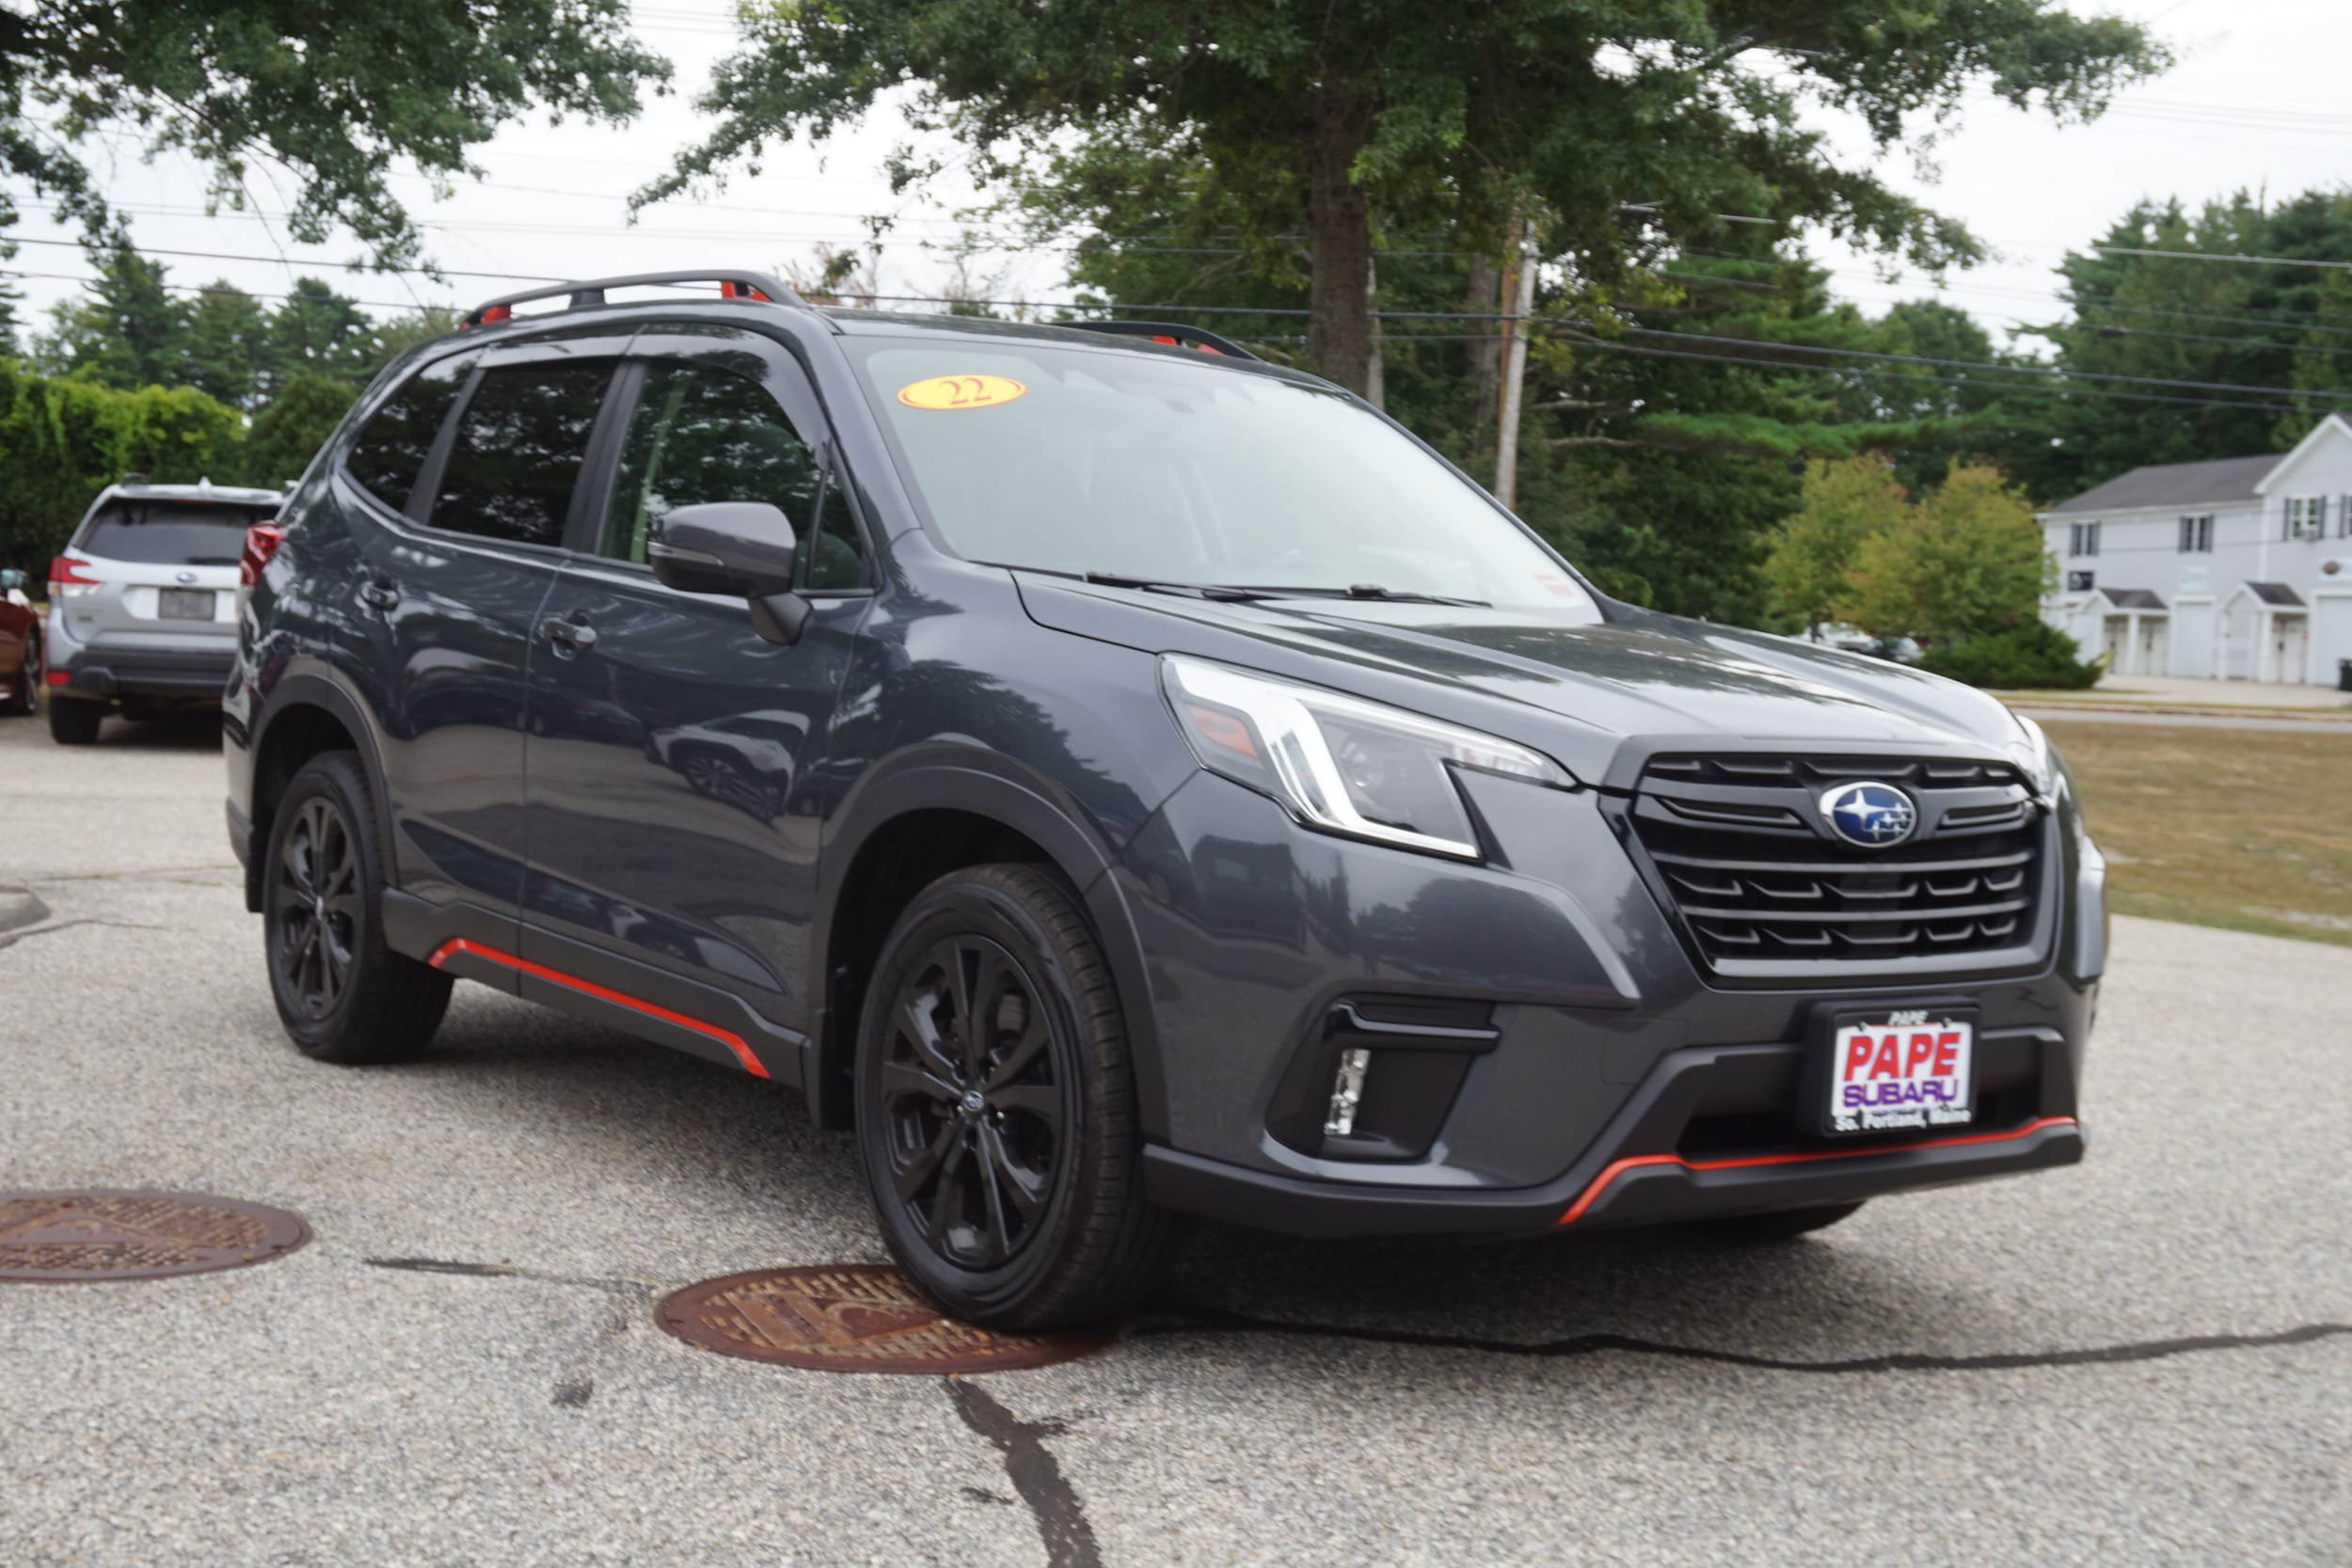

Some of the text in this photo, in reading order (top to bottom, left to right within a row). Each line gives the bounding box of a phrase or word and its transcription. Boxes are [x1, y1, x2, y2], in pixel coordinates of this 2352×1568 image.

[940, 377, 992, 404] 22
[1887, 1010, 1929, 1025] PAPE
[1844, 1032, 1960, 1081] PAPE
[1843, 1080, 1958, 1107] SUBARU
